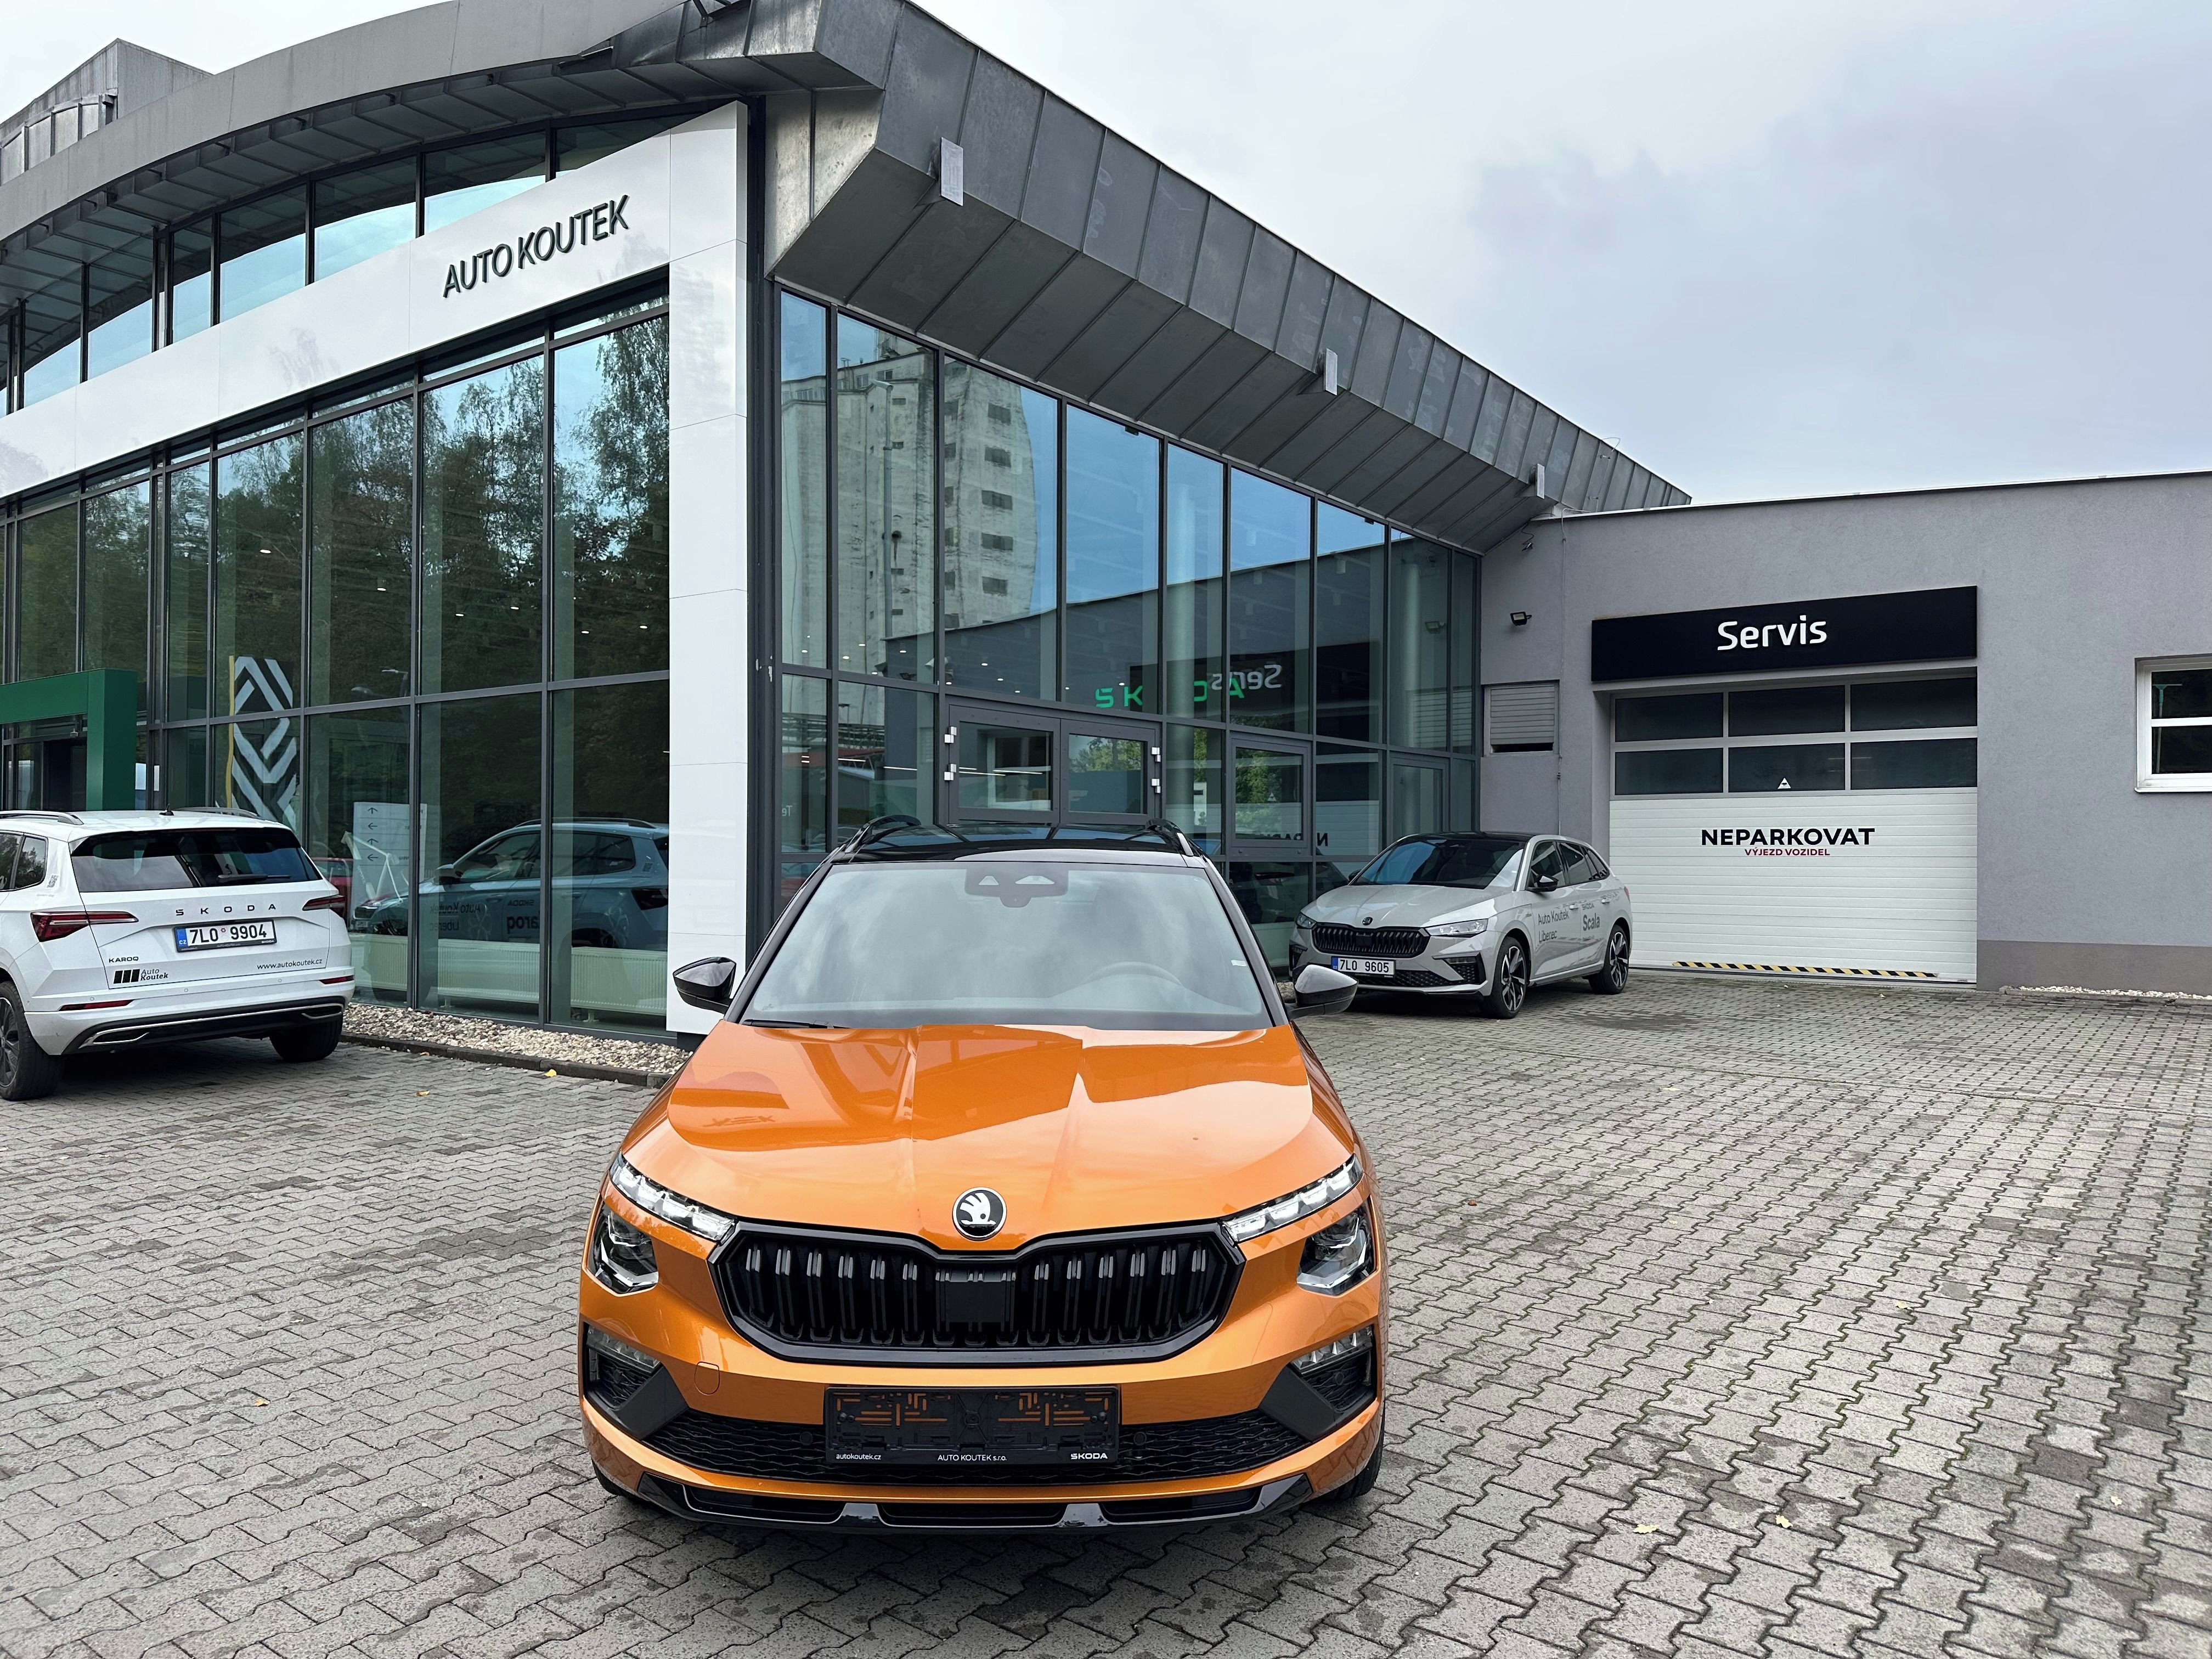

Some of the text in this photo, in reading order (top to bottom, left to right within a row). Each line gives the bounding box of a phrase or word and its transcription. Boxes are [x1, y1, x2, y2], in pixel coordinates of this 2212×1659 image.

[442, 194, 629, 298] AUTO KOUTEK
[1717, 614, 1827, 651] Servis
[1094, 677, 1245, 708] SKDA
[1701, 828, 1875, 845] NEPARKOVAT
[1745, 847, 1783, 856] VÝJEZD
[176, 904, 276, 916] SKODA
[1538, 909, 1570, 926] Auto Koutek
[1583, 912, 1600, 932] Scala
[189, 928, 219, 944] 7L0
[230, 924, 267, 940] 9904
[1538, 930, 1558, 943] Liberec
[257, 958, 323, 970] www.autokoutek.cz
[1340, 960, 1357, 970] 7L0
[1365, 961, 1389, 973] 9605
[140, 973, 168, 981] Koutek
